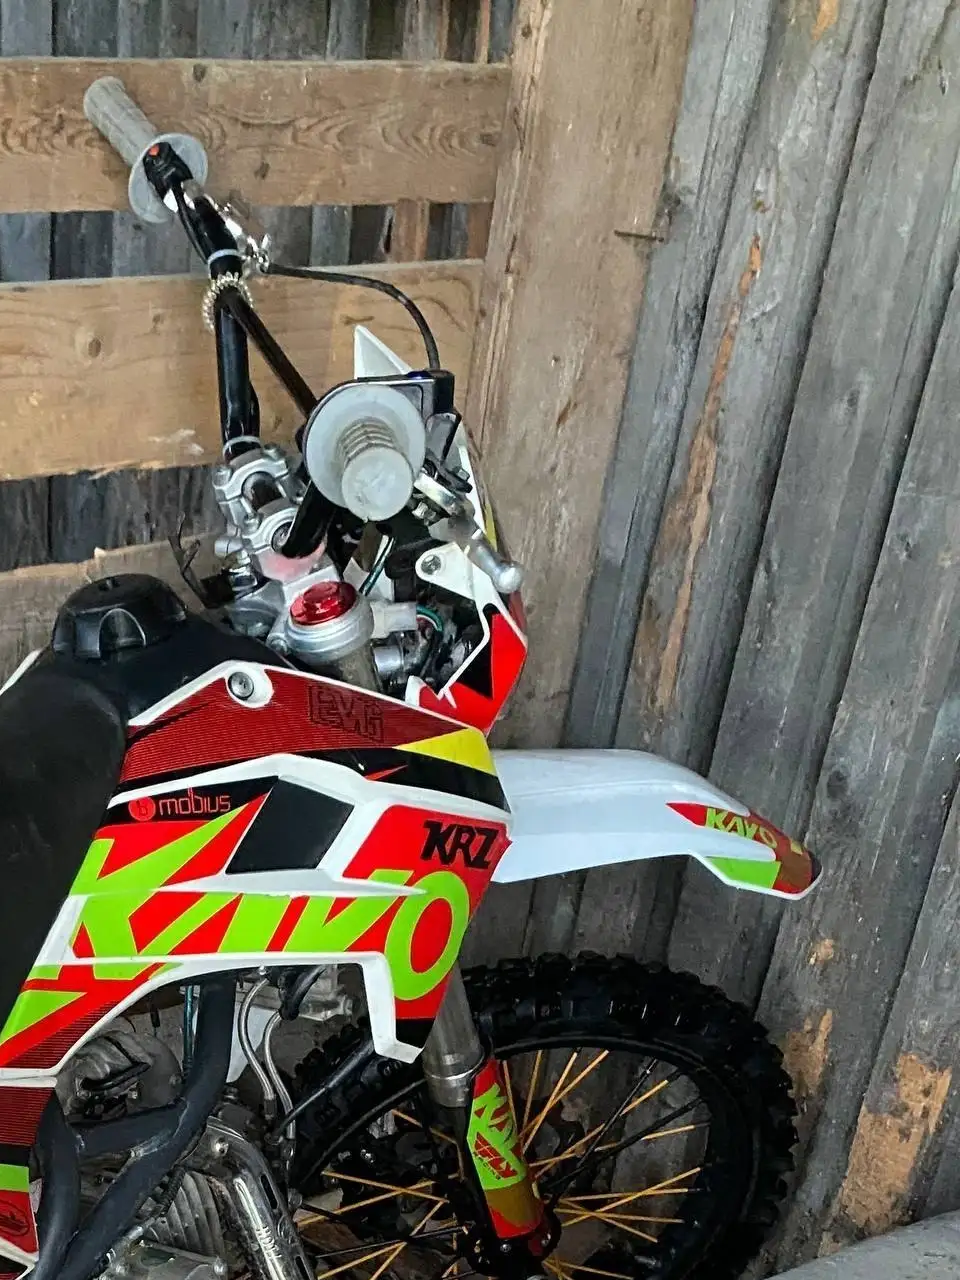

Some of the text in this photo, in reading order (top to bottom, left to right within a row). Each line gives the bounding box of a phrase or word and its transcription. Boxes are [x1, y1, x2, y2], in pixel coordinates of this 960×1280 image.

[159, 787, 231, 816] mobius
[421, 820, 499, 870] KRZ
[703, 807, 778, 849] KAYO
